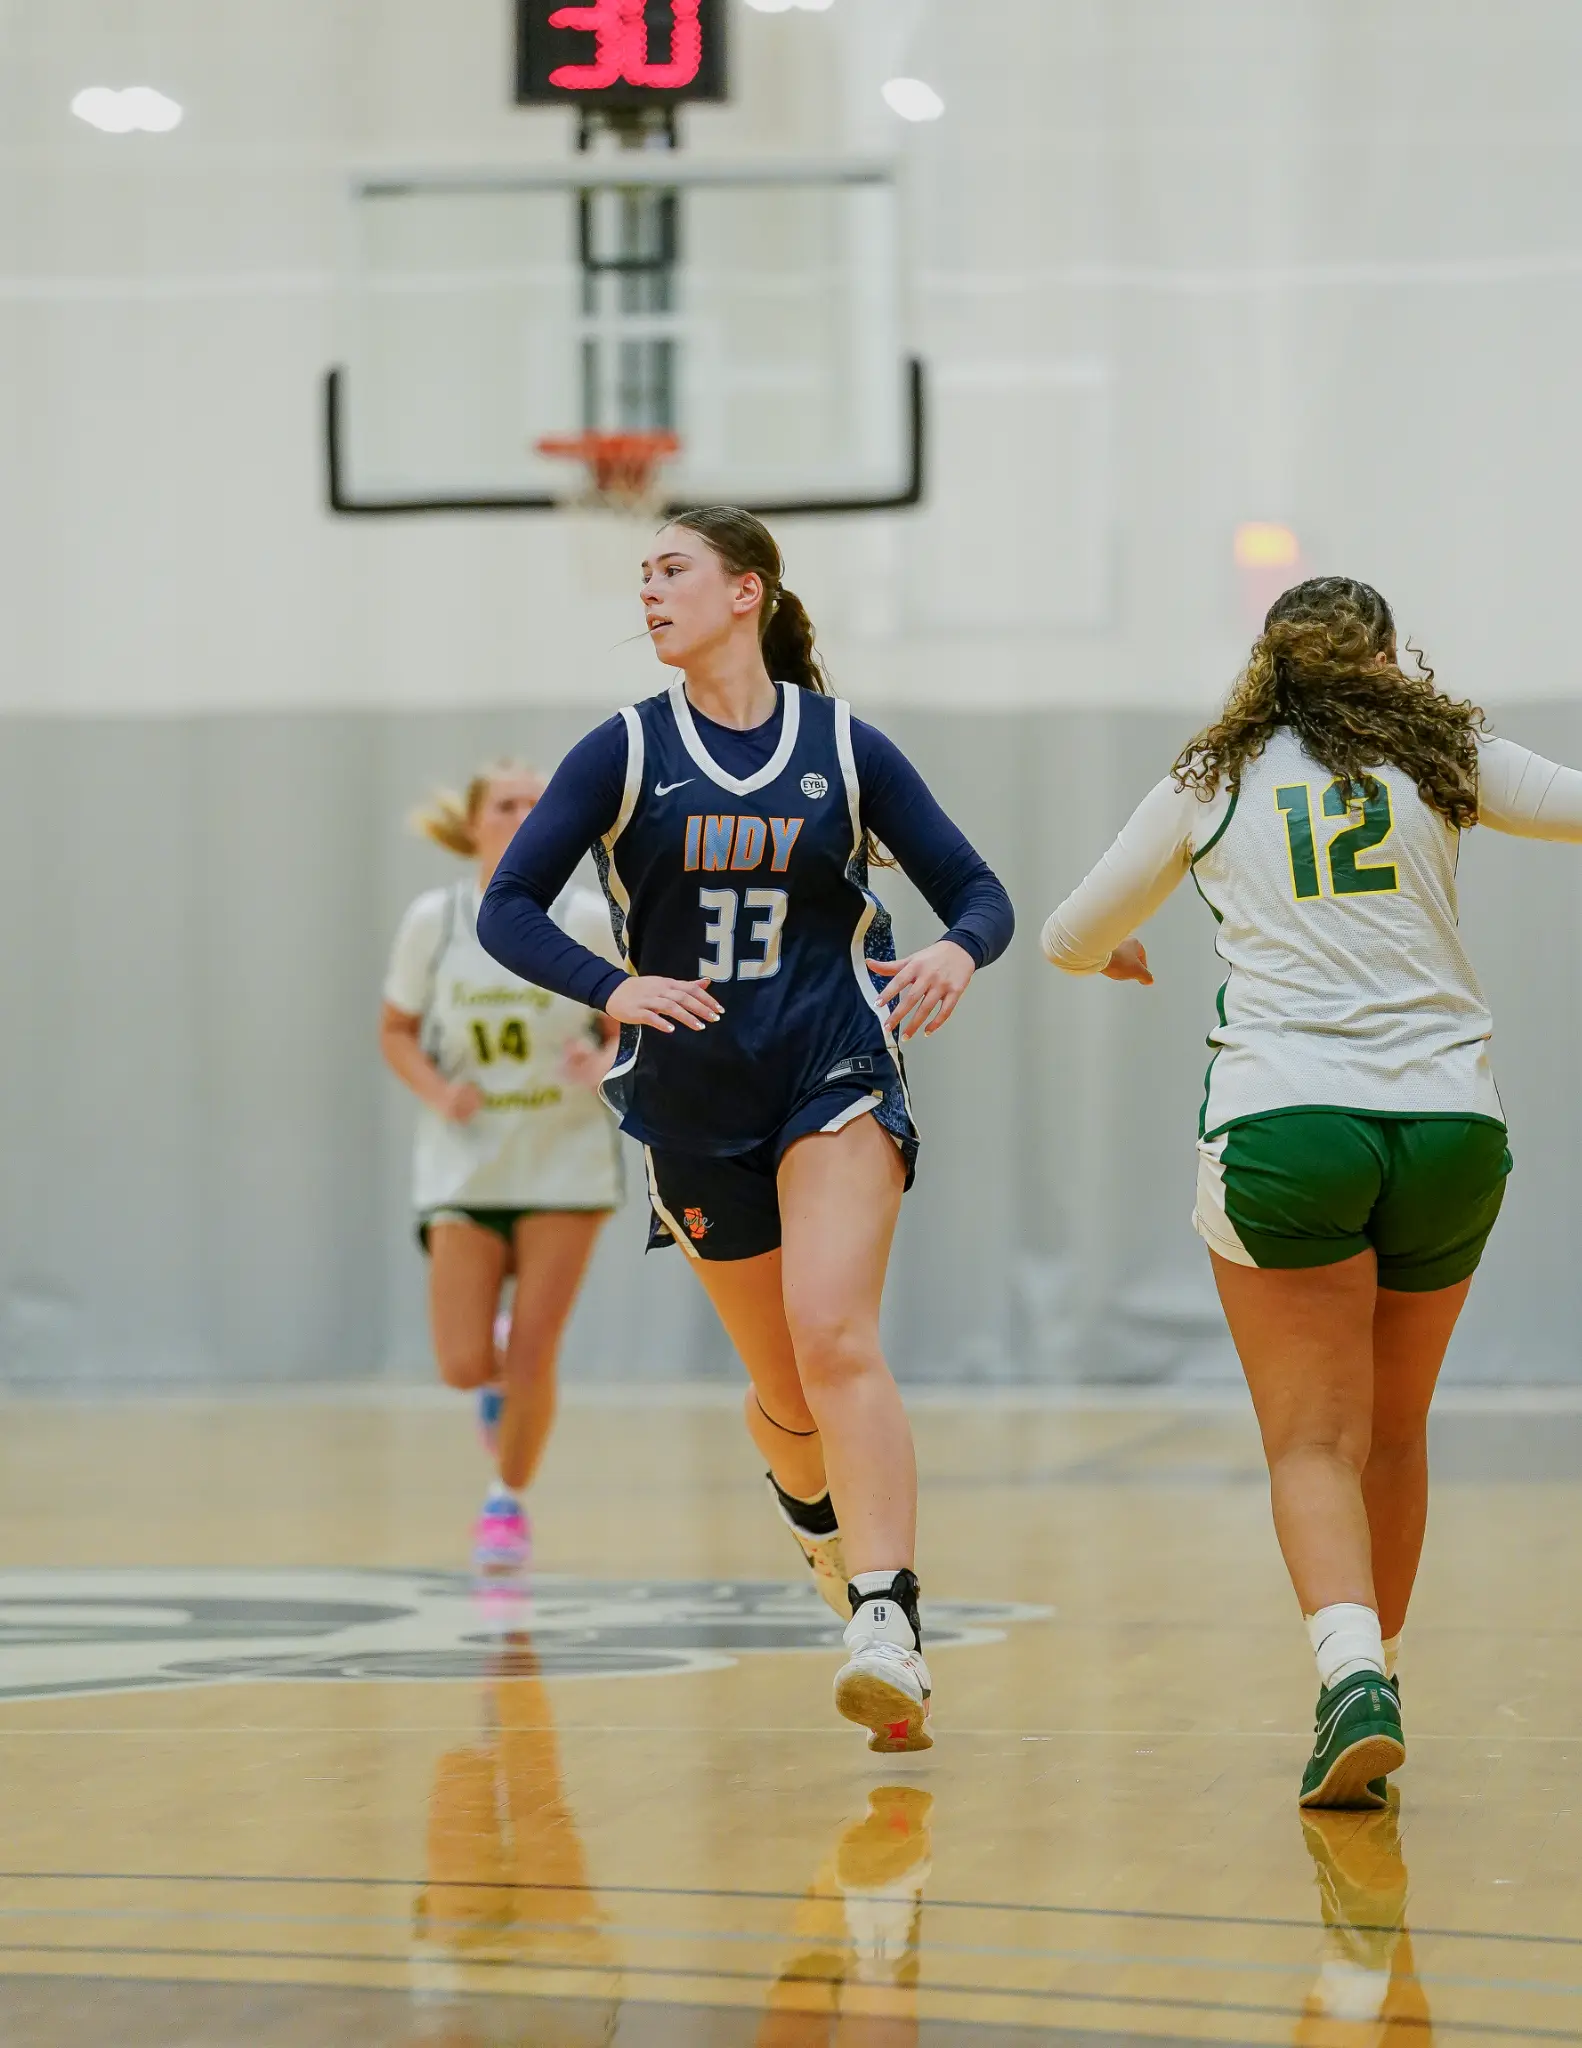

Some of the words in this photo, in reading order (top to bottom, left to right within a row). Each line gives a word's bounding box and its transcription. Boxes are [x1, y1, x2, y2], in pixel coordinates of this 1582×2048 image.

[548, 0, 702, 90] 30
[803, 780, 826, 789] EYBL
[684, 815, 805, 873] INDY
[1272, 773, 1400, 903] 12
[699, 887, 789, 983] 33
[468, 1016, 530, 1066] 14
[858, 1061, 865, 1069] L
